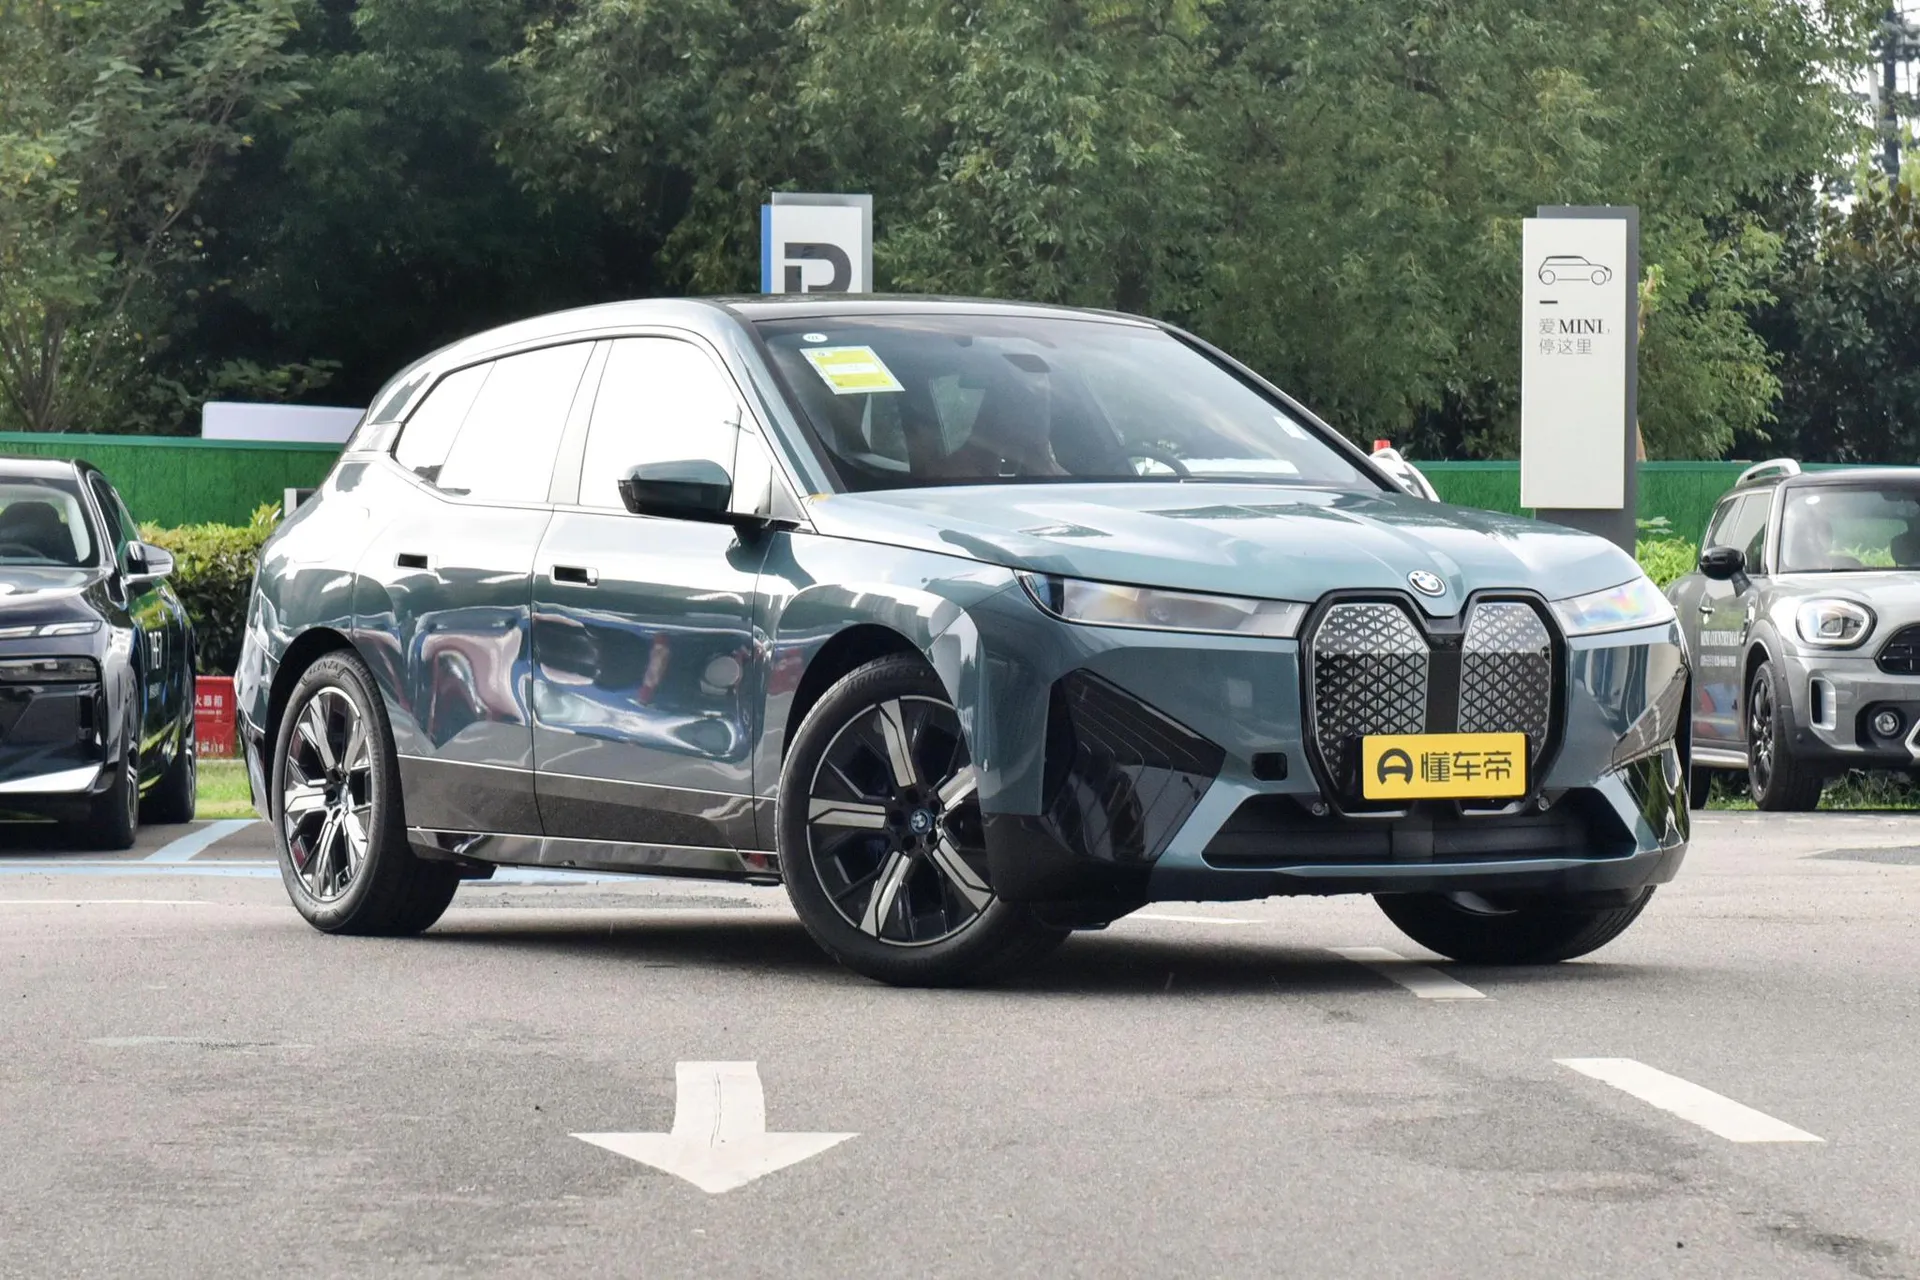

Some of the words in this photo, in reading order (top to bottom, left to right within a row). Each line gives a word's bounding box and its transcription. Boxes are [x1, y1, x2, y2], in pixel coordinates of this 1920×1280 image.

[784, 242, 852, 293] P
[1539, 318, 1556, 335] 爱
[1539, 337, 1593, 355] 停这里
[1420, 750, 1512, 783] 懂车帝
